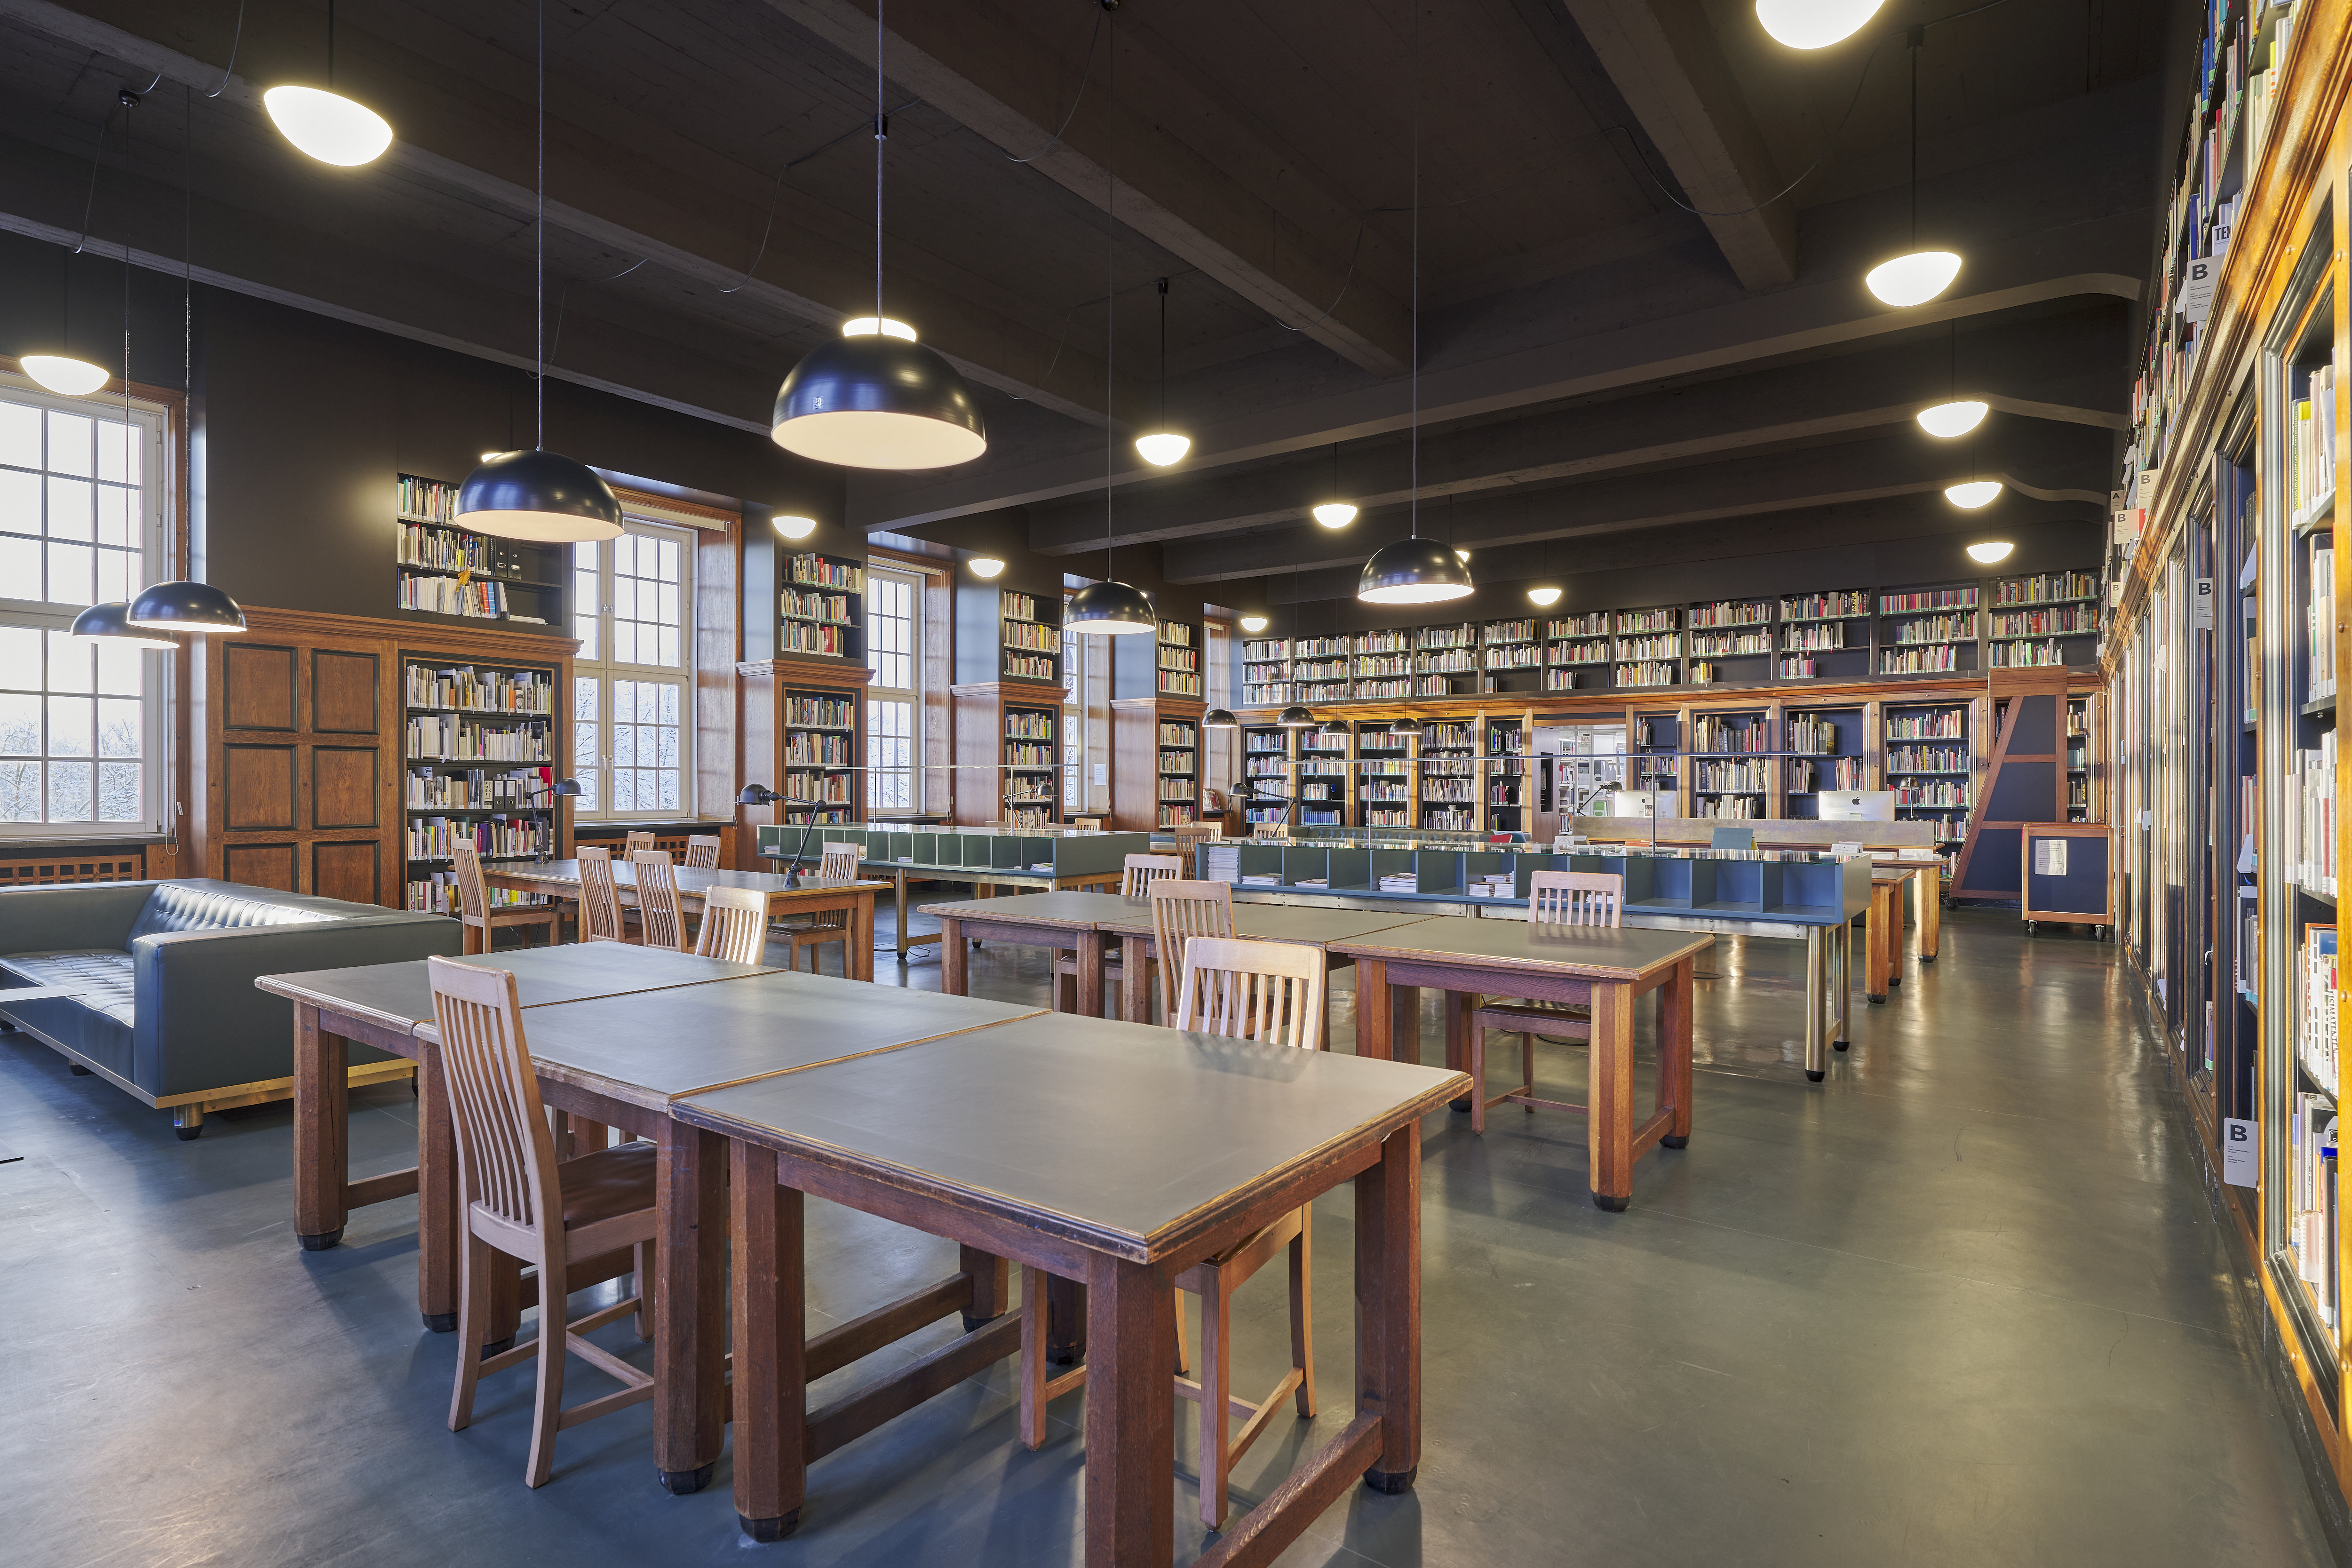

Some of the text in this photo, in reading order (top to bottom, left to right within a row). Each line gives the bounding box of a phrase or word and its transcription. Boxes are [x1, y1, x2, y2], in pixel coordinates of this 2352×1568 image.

[2192, 264, 2208, 281] B
[2141, 475, 2150, 485] B
[2118, 514, 2126, 522] B
[2199, 582, 2211, 595] B
[2230, 1124, 2248, 1141] B
